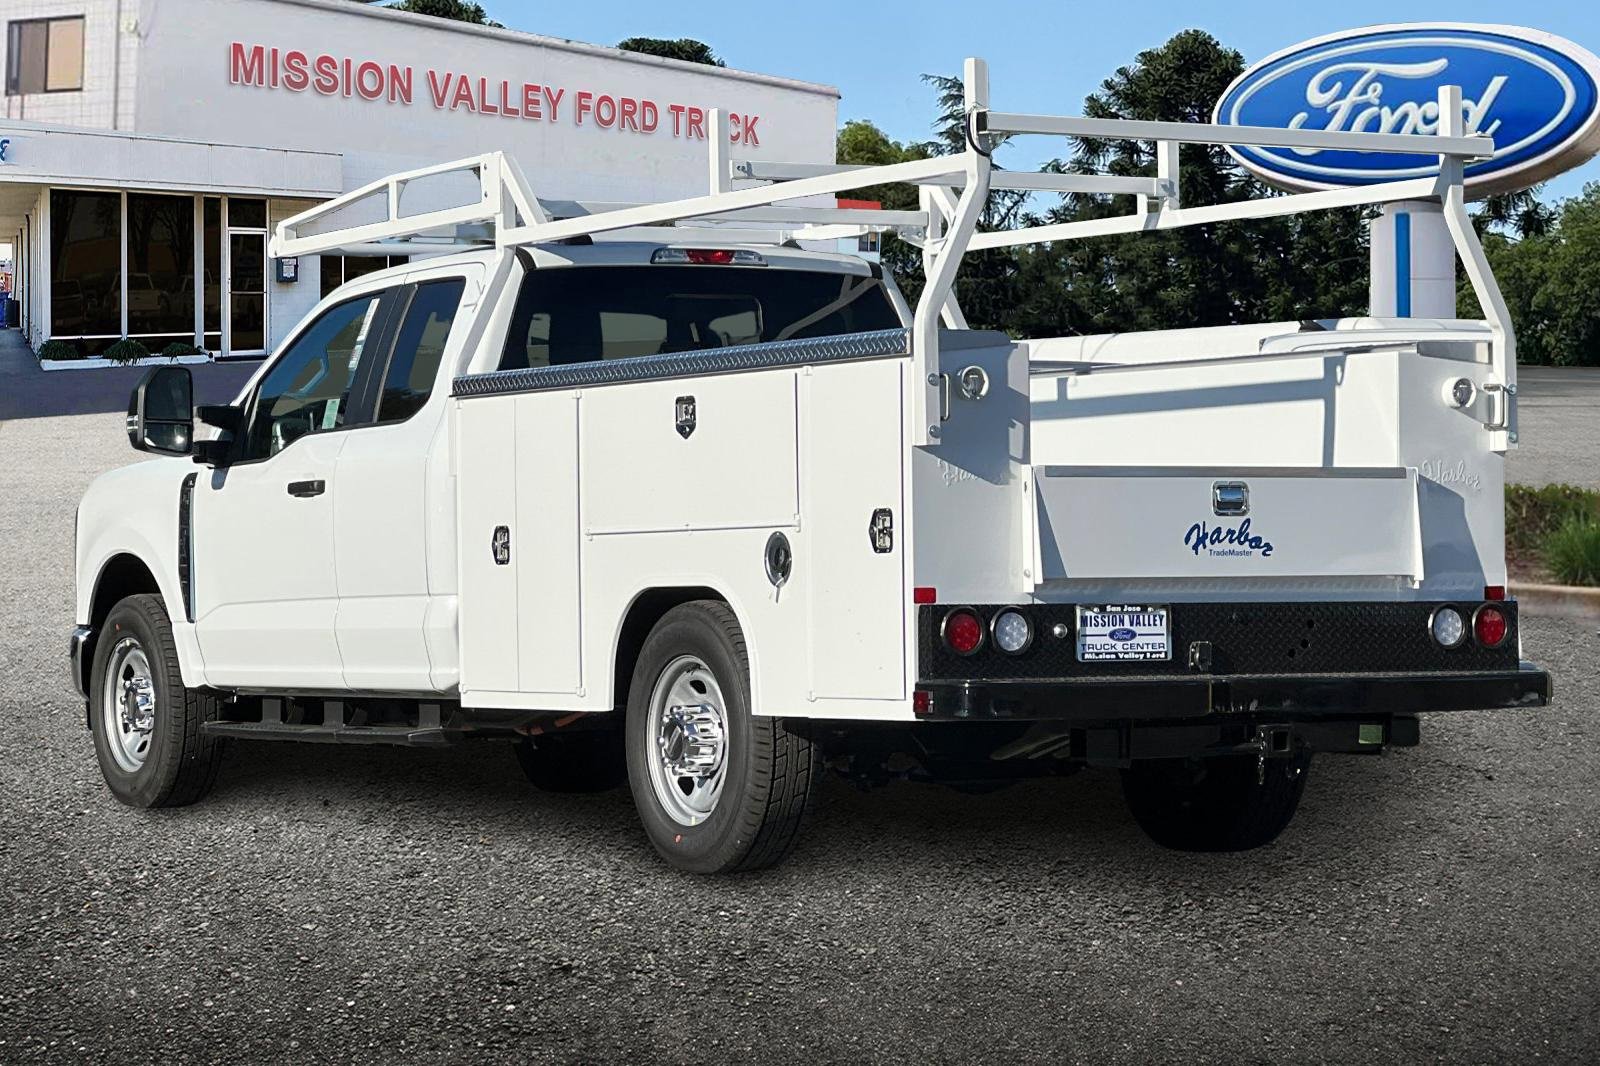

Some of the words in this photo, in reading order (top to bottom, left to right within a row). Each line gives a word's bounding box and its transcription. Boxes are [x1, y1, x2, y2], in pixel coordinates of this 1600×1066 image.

[230, 42, 414, 105] MISSION
[427, 69, 565, 122] VALLEY
[575, 90, 659, 134] FORD
[668, 103, 760, 146] TRCK
[1289, 57, 1509, 156] Ford
[1184, 517, 1274, 557] Harbor
[1208, 549, 1253, 557] TradeMaster
[1080, 615, 1125, 627] MISSION
[1129, 615, 1165, 627] VALLEY
[1081, 643, 1118, 652] TRUCK
[1121, 642, 1166, 651] CENTER
